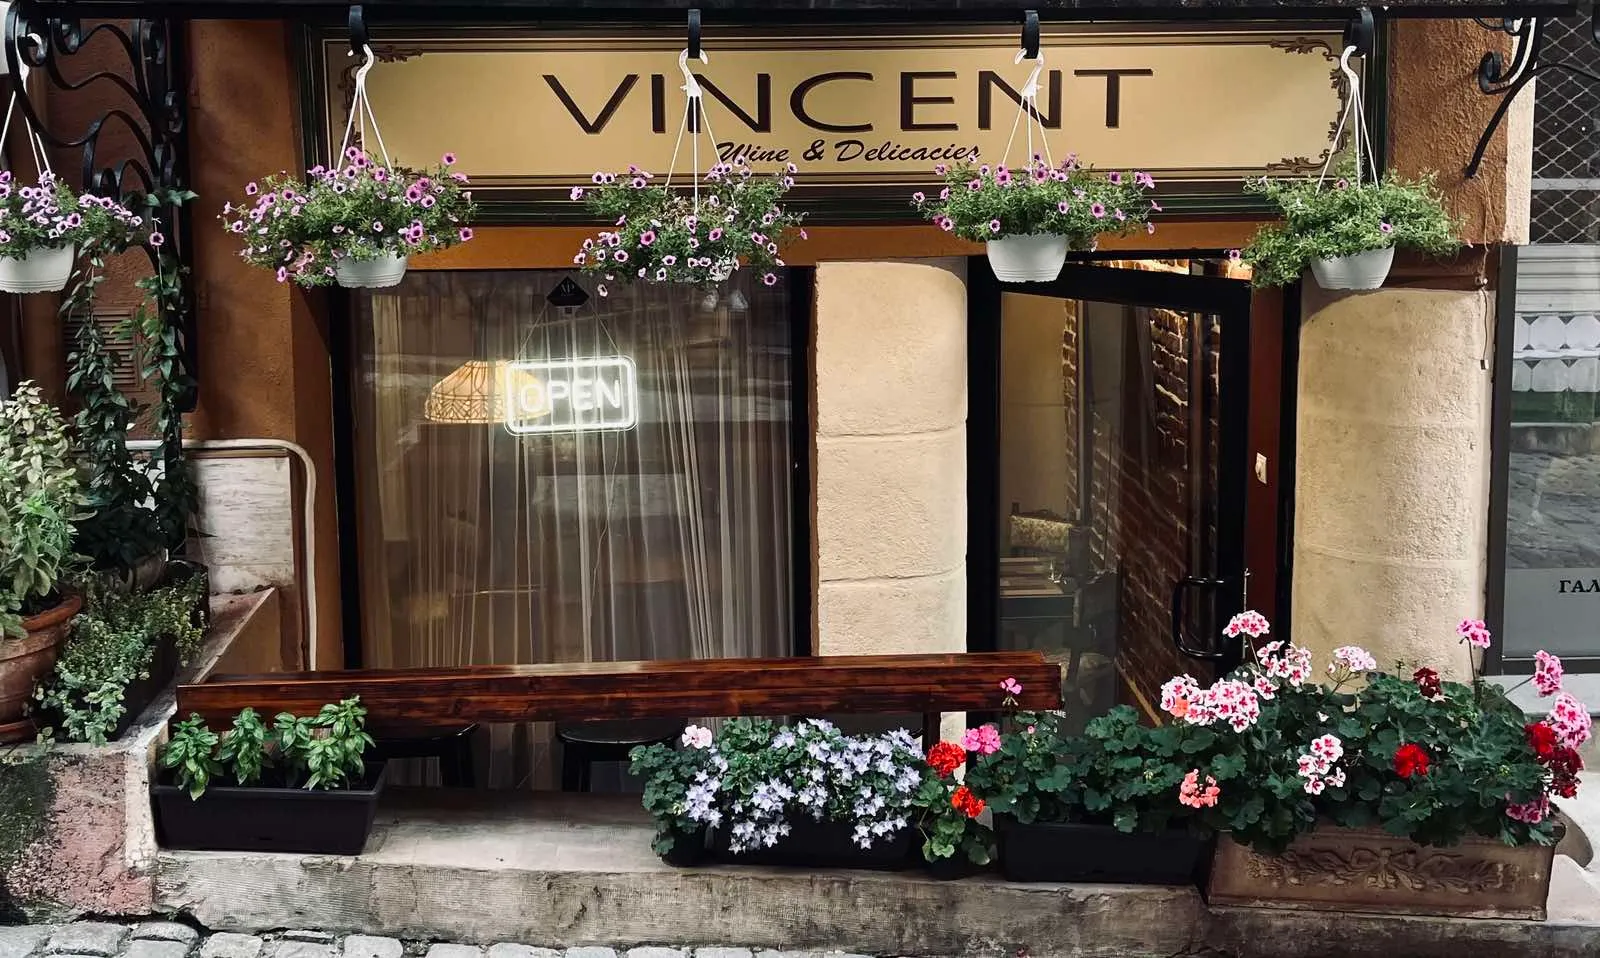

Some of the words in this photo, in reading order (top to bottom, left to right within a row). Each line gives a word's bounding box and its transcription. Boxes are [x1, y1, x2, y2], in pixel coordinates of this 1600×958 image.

[542, 68, 1153, 135] VINCENT
[716, 141, 789, 162] Wine
[802, 139, 825, 161] &
[834, 139, 980, 162] Delicacies
[520, 378, 621, 413] OPEN
